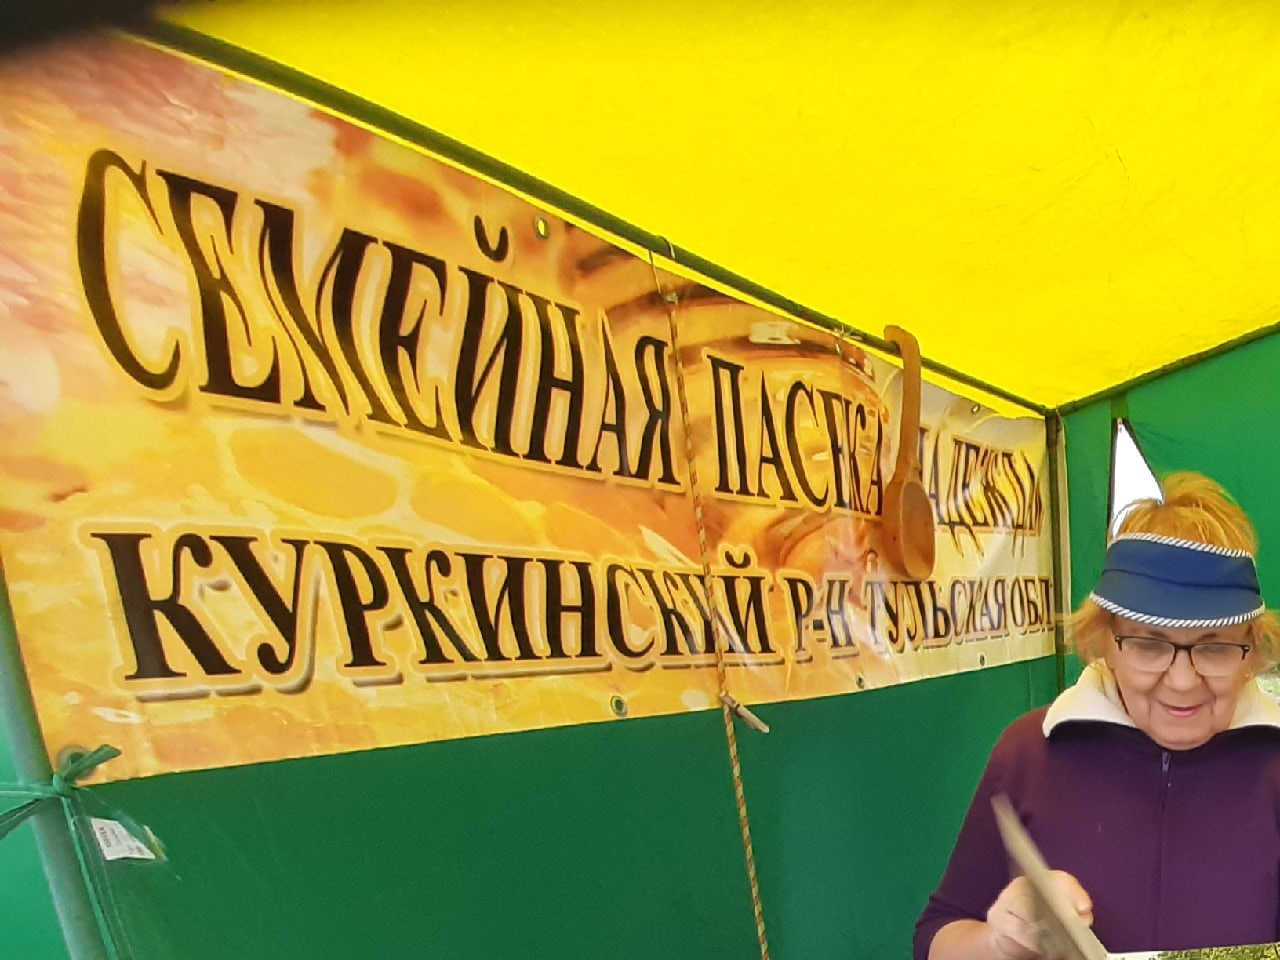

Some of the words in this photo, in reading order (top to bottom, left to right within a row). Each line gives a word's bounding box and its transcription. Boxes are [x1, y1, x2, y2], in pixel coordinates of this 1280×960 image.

[78, 148, 682, 486] СЕМЕЙНАЯ
[707, 355, 883, 516] ПАСЕКА
[918, 426, 1043, 558] АДЕЖДА
[91, 532, 777, 681] КУРКИНСКИЙ
[784, 577, 855, 651] Р-Н
[865, 576, 1009, 645] ТУЛЬСКАЯ
